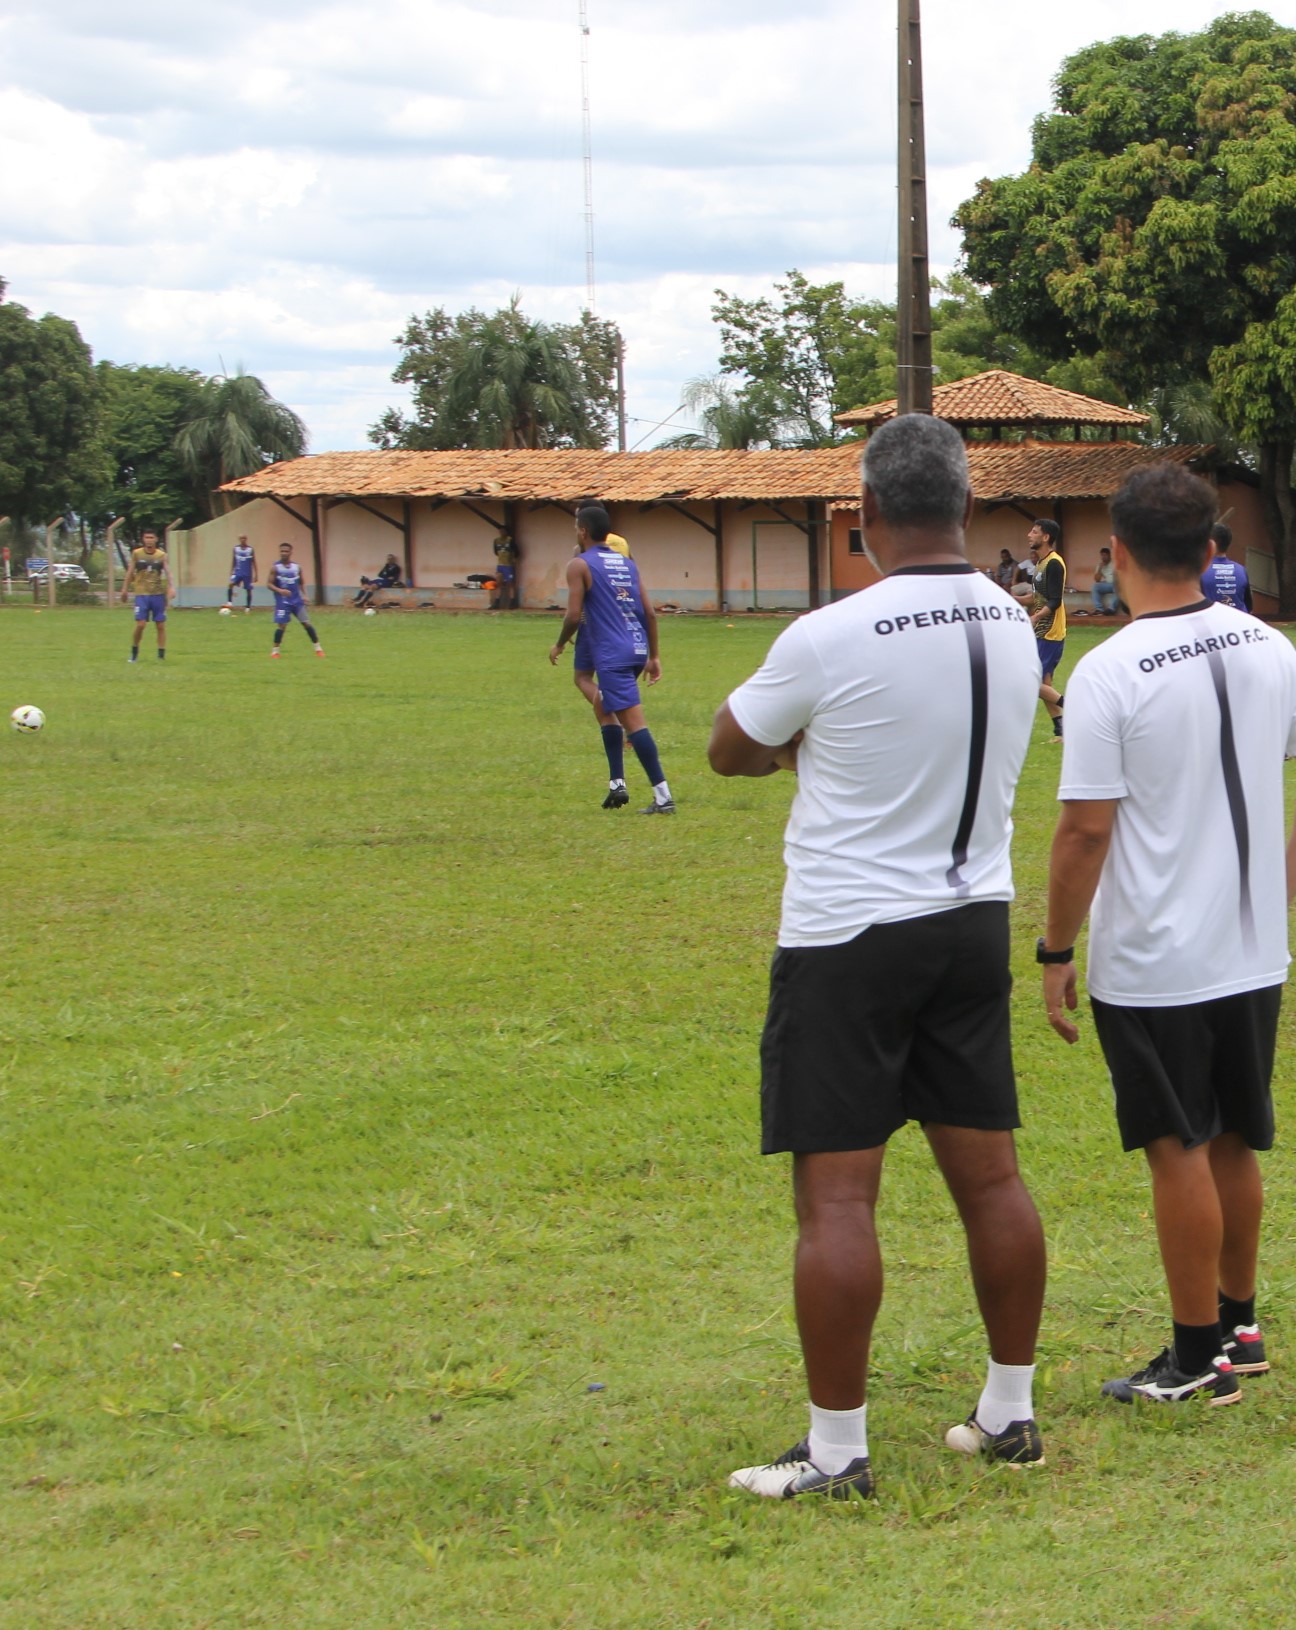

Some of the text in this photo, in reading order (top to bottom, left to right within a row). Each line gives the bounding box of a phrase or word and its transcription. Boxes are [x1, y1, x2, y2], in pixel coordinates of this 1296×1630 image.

[874, 604, 1002, 636] OPERÁRIO
[1139, 627, 1270, 674] OPERÁRIO F.C.
